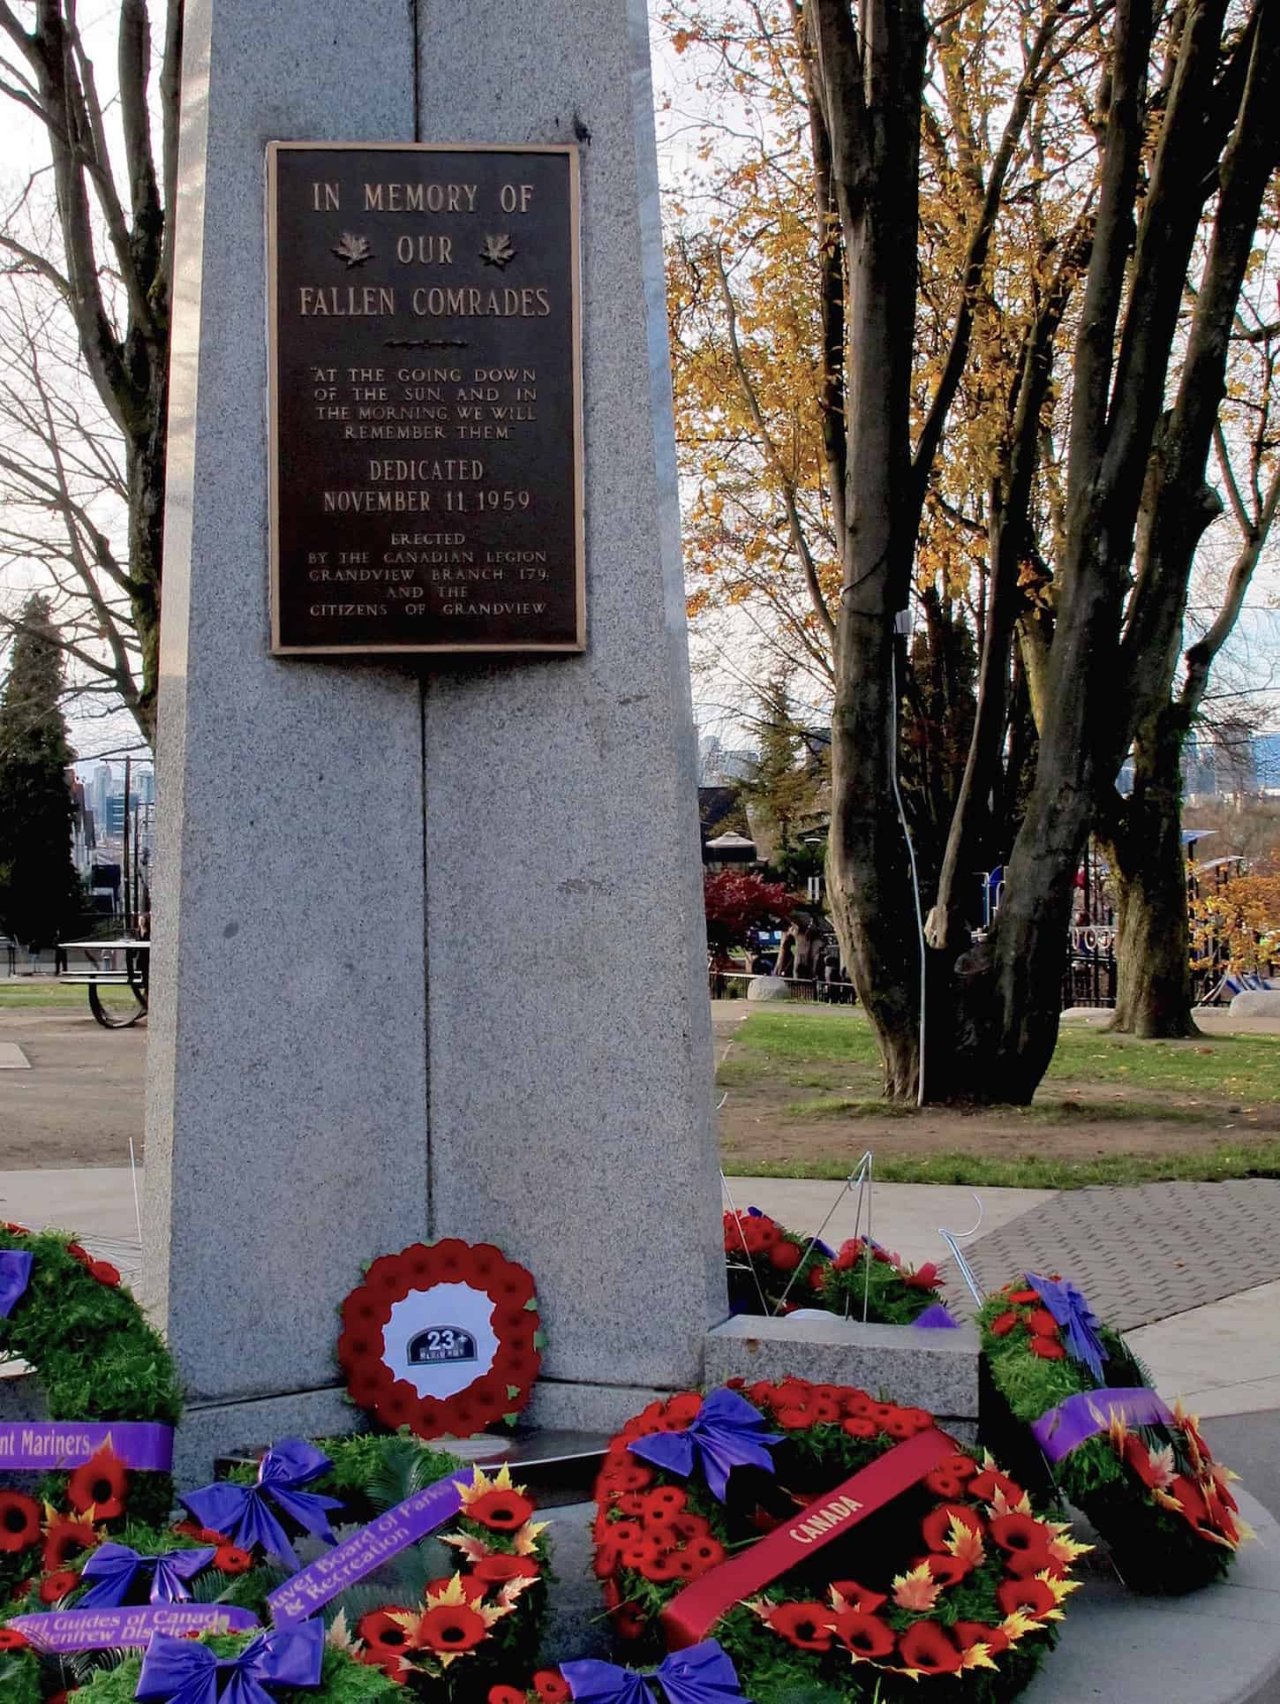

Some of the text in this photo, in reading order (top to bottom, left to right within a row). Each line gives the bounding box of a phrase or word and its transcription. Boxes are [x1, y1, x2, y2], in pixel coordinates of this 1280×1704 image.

[313, 182, 534, 213] IN MEMORY OF
[397, 235, 452, 265] OUR
[299, 286, 551, 317] FALLEN COMRADES
[348, 368, 385, 382] THE
[398, 368, 462, 382] GOING
[474, 368, 537, 382] DOWN
[314, 387, 338, 401] OF
[353, 388, 388, 401] THE
[457, 387, 500, 401] AND
[517, 387, 537, 401] IN
[317, 407, 350, 421] THE
[457, 407, 484, 421] WE
[492, 407, 538, 421] WILL
[345, 426, 447, 440] REMEMBER
[369, 459, 484, 482] DEDICATED
[324, 491, 431, 512] NOVEMBER
[478, 490, 531, 512] 1959
[391, 532, 466, 546] ERECTED
[308, 550, 548, 564] BY THE CANADIAN LEGION
[309, 568, 415, 582] GRANDVIEW
[432, 567, 504, 581] BRANCH
[386, 585, 469, 599] AND THE
[309, 601, 548, 617] CITIZENS OF GRANDVIEW
[21, 1428, 90, 1456] Mariners
[789, 1495, 864, 1544] CANADA
[269, 1483, 454, 1611] uver Board of Parks
[284, 1525, 410, 1617] & Recreation
[53, 1614, 121, 1631] Guides
[126, 1612, 146, 1626] of
[153, 1609, 230, 1625] Canad
